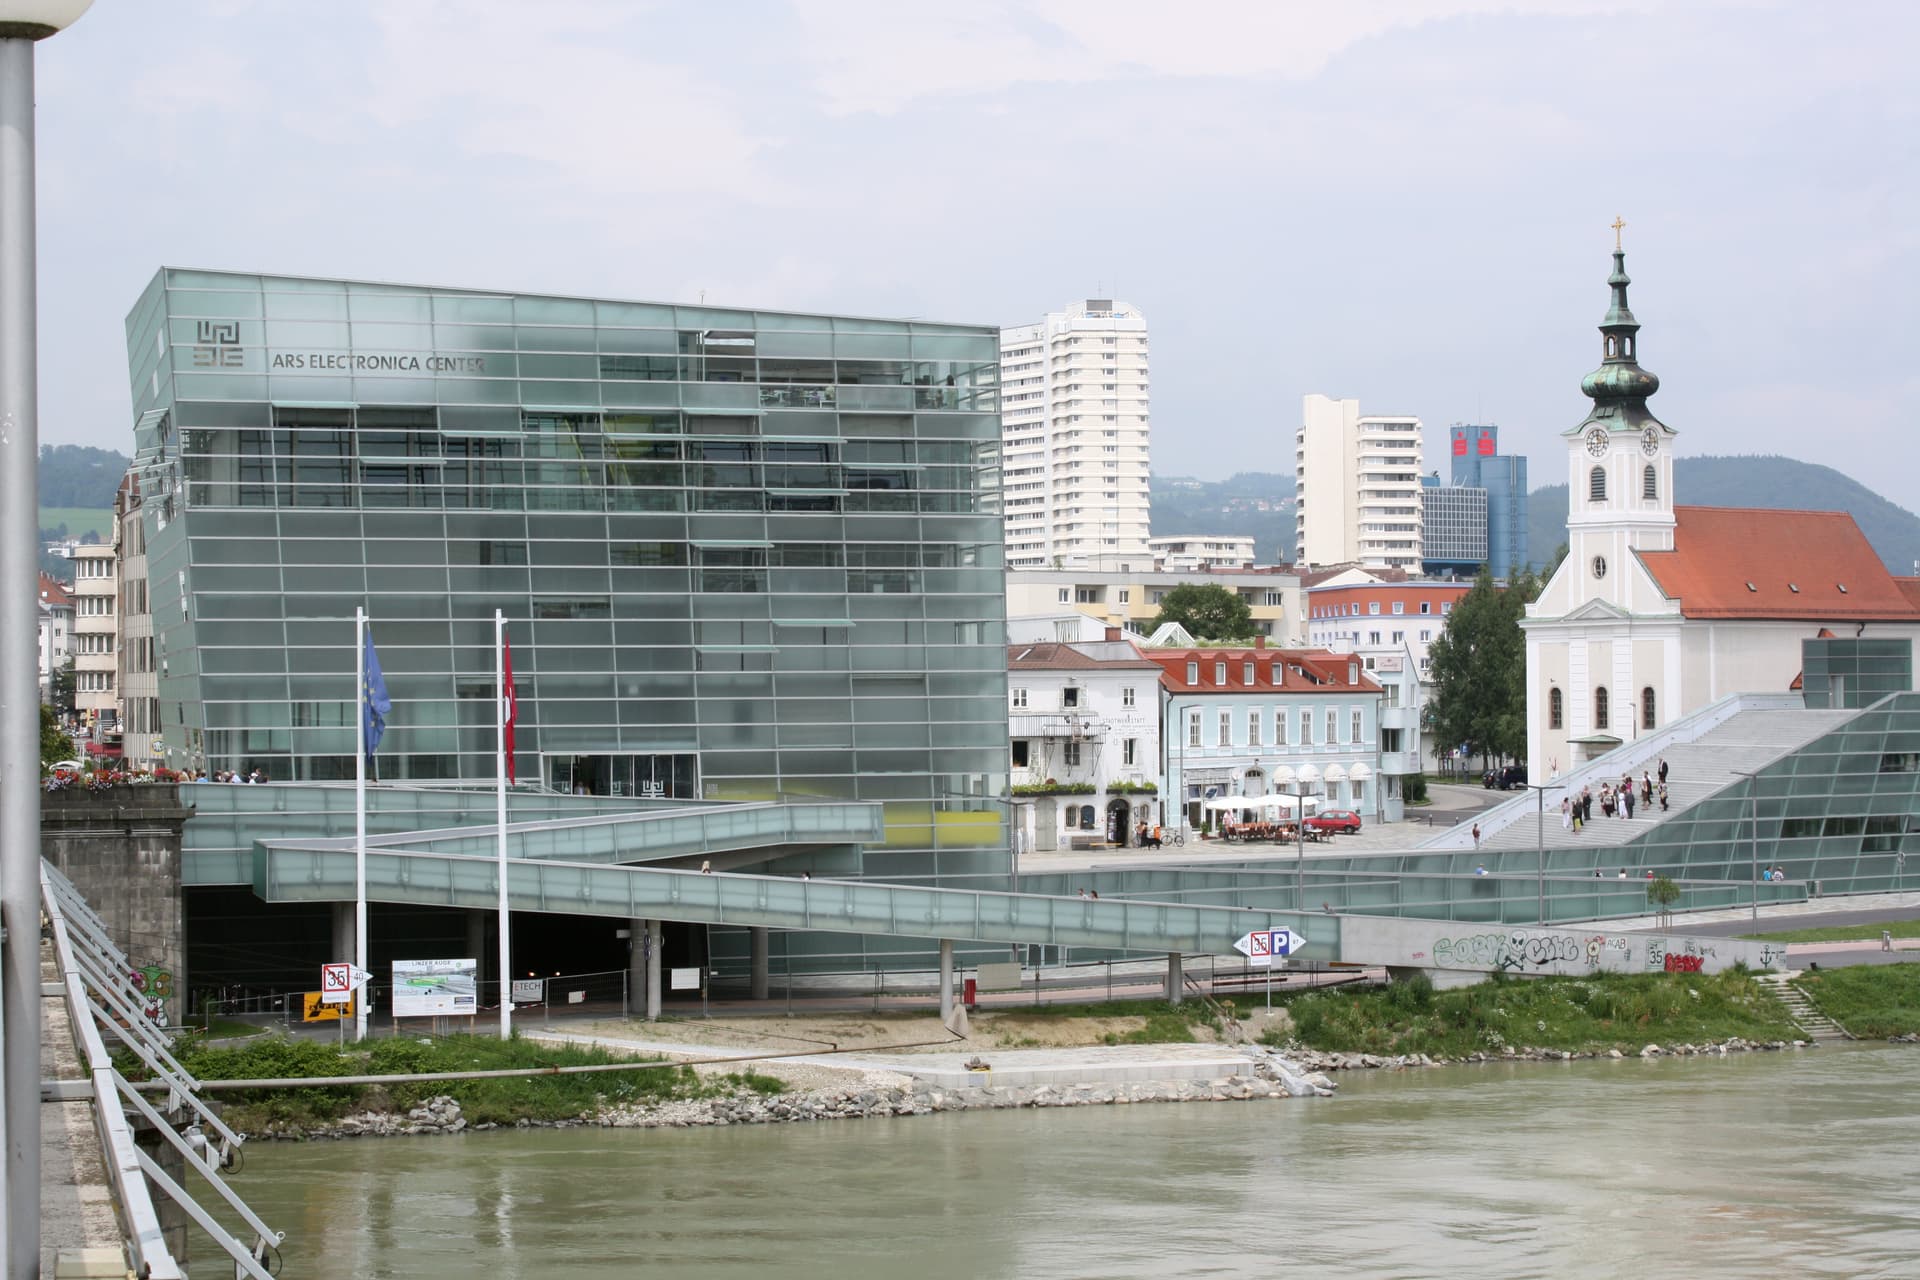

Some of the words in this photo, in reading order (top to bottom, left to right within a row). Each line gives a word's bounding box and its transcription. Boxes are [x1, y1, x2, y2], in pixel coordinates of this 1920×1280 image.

[272, 353, 305, 369] ARS
[309, 354, 420, 371] ELECTRONICA
[425, 356, 486, 373] CENTER
[1254, 937, 1267, 952] 35
[1273, 933, 1287, 953] P
[1649, 950, 1663, 965] 35
[327, 970, 346, 987] 35
[353, 972, 364, 981] 40
[514, 982, 541, 992] ETECH
